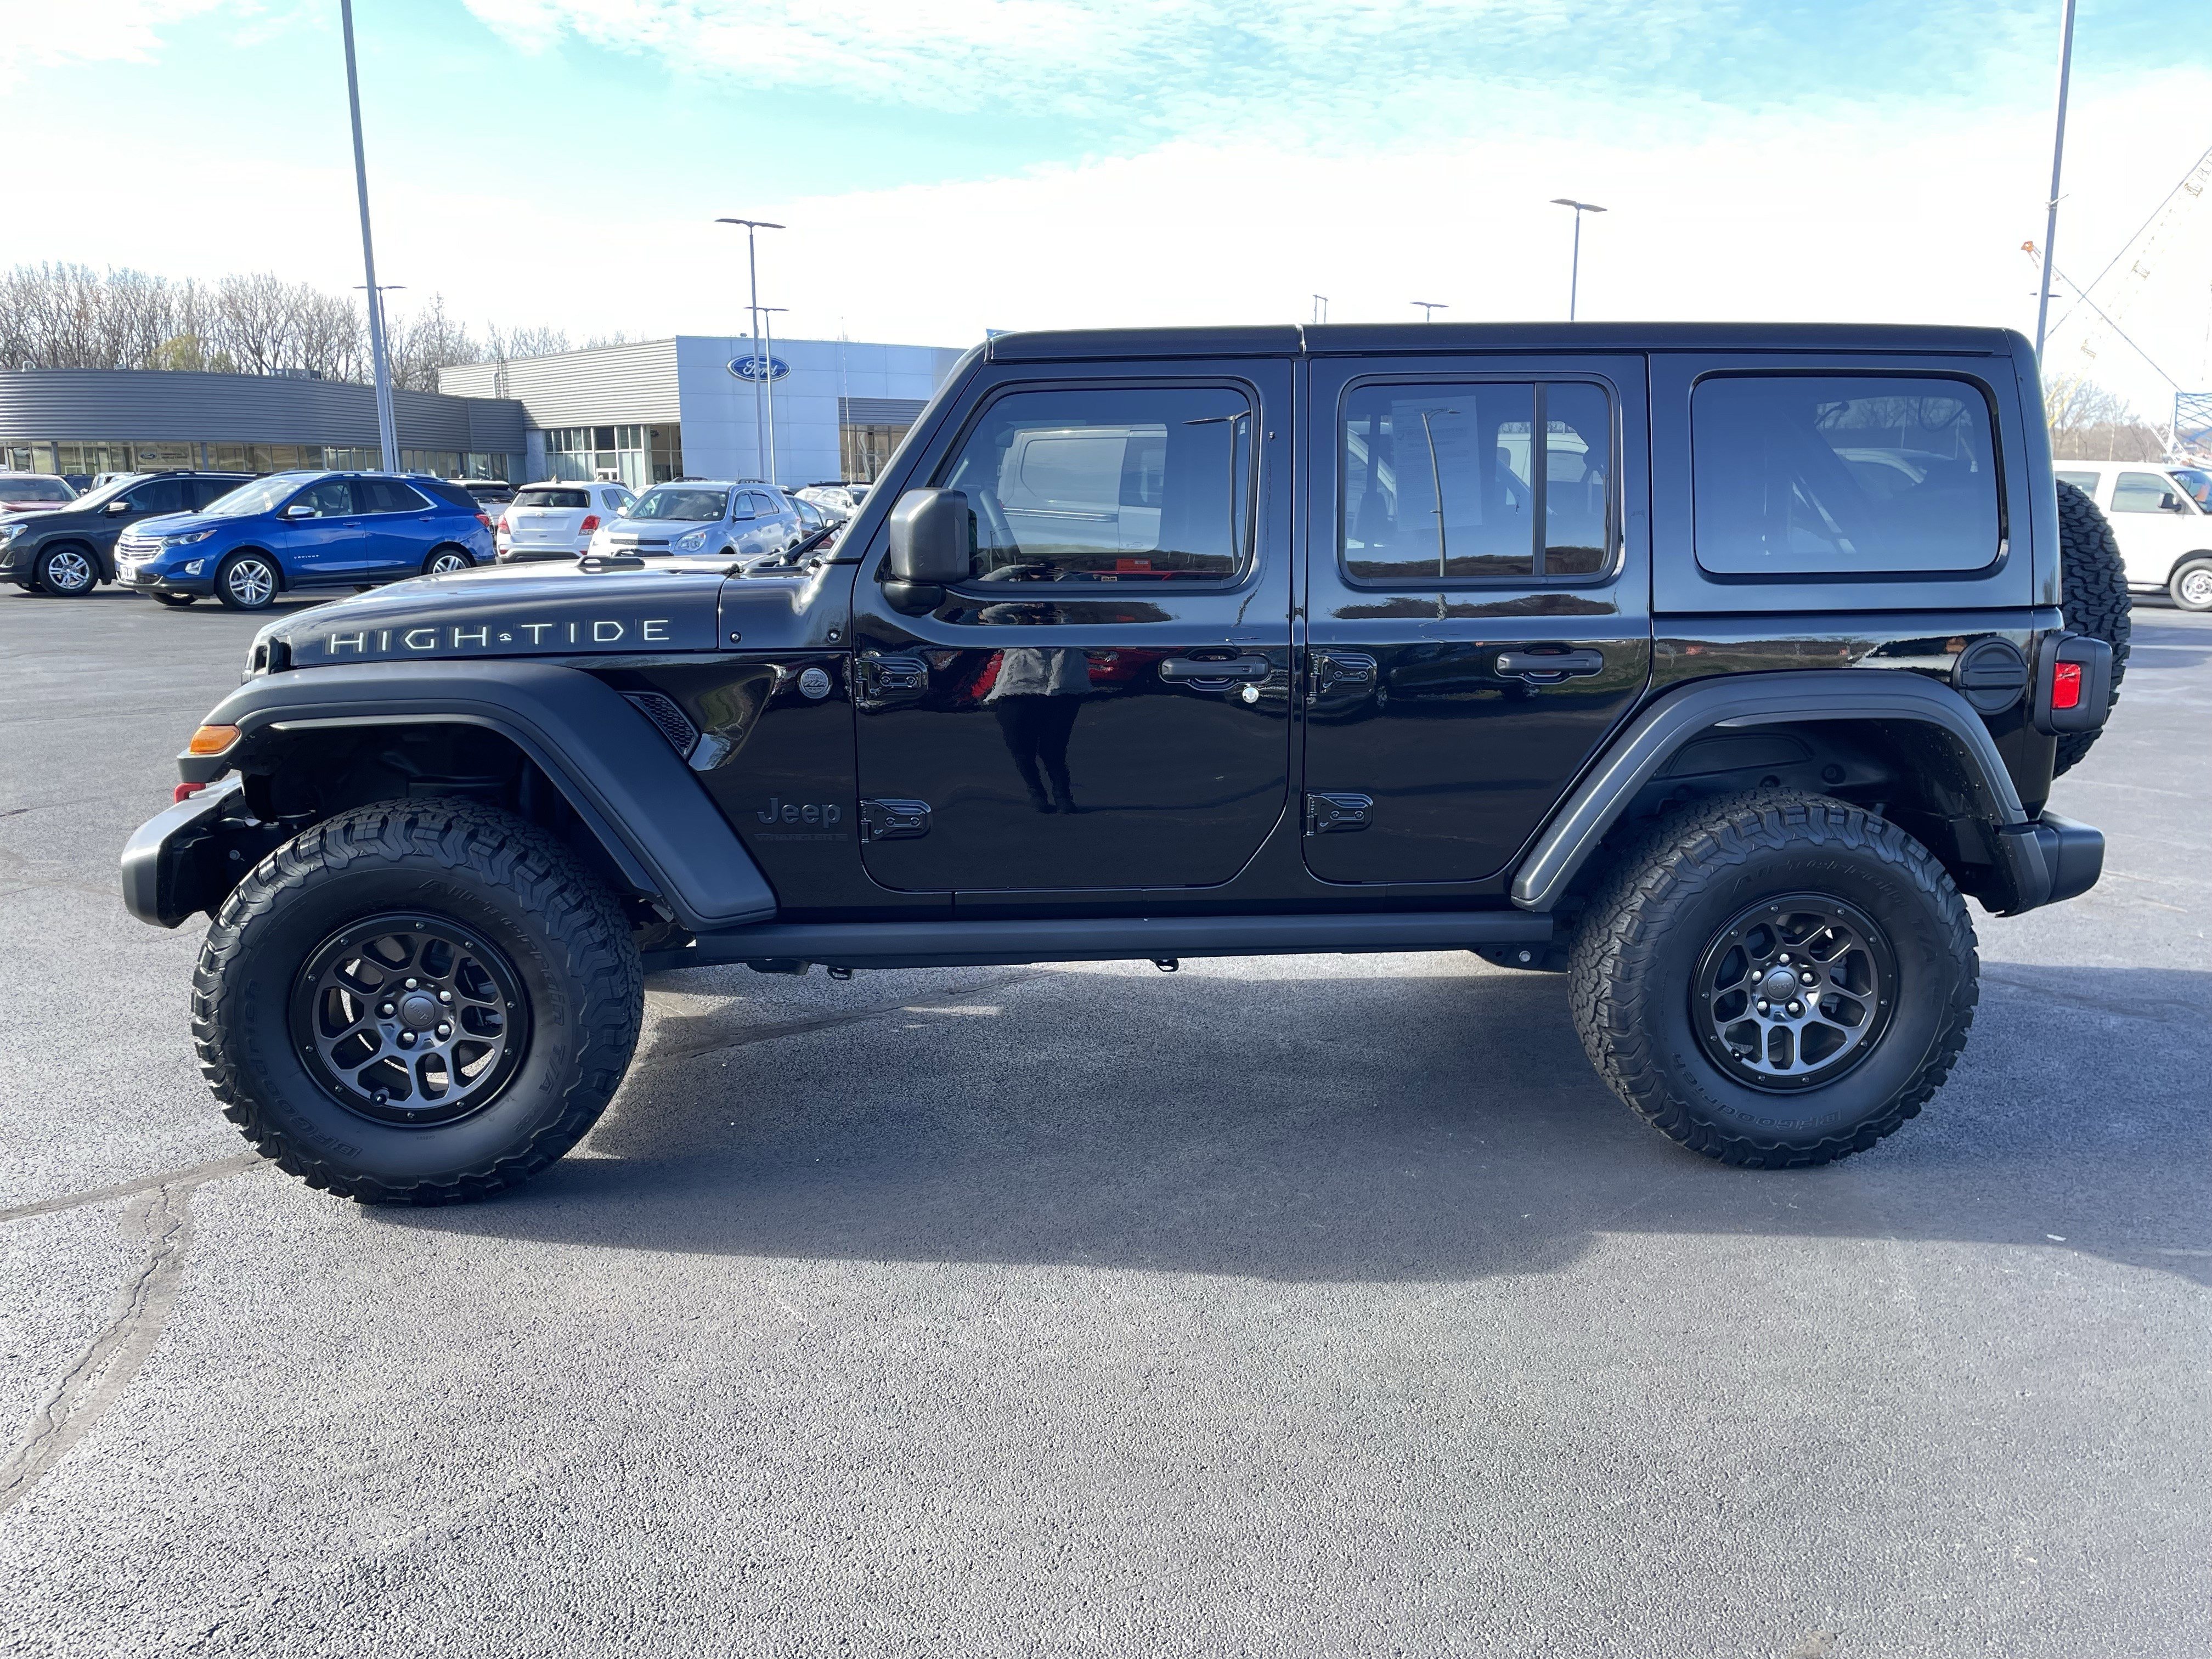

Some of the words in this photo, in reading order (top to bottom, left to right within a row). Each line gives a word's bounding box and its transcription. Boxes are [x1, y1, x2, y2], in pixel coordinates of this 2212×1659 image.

[330, 627, 488, 653] HIGH
[520, 620, 670, 645] TIDE
[757, 798, 842, 830] Jeep
[408, 1002, 430, 1020] Jeep
